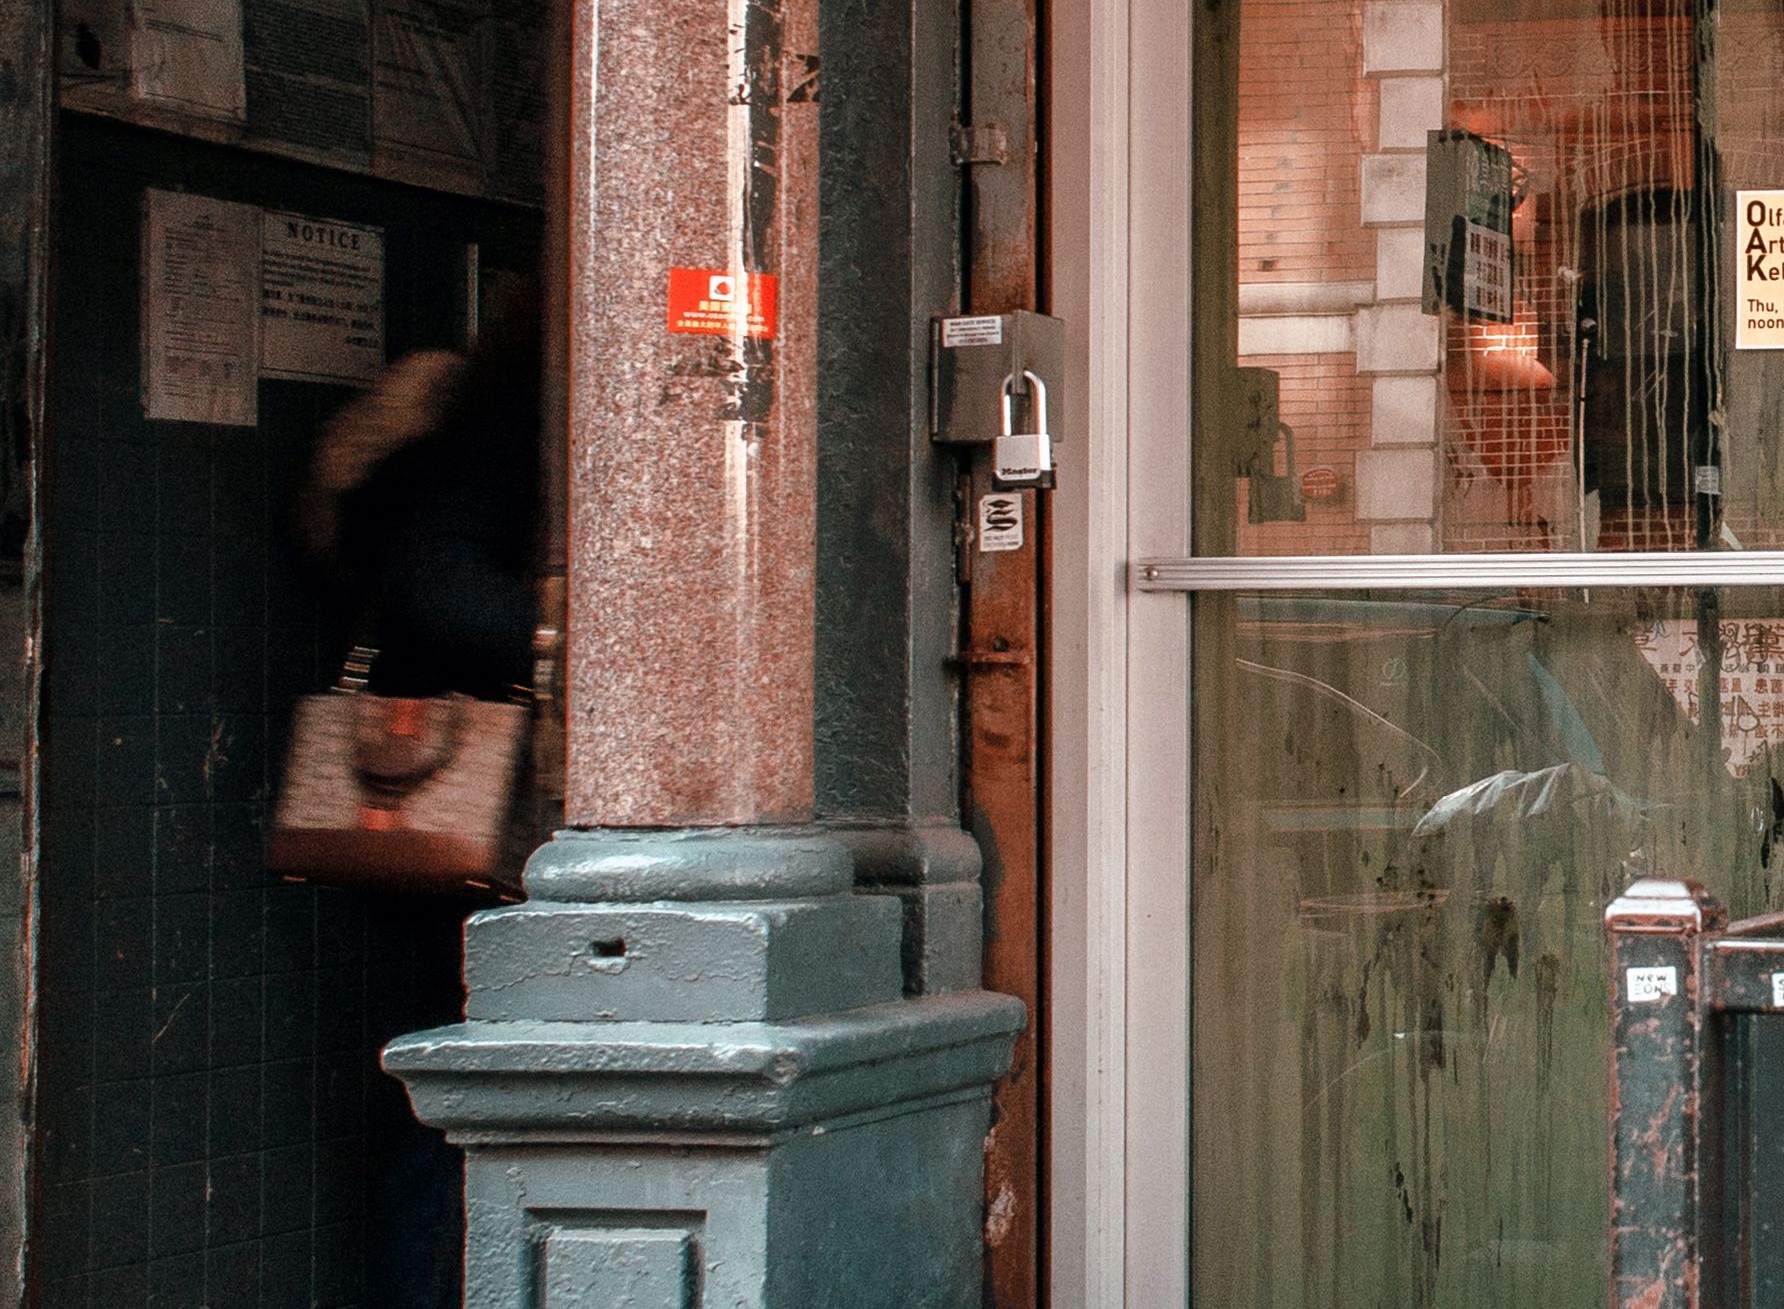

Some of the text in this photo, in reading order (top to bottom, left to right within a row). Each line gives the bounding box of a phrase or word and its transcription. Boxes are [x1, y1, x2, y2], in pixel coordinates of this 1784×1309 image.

[288, 221, 361, 251] NOTICE
[1748, 298, 1778, 314] Thu,
[1747, 317, 1784, 329] noon
